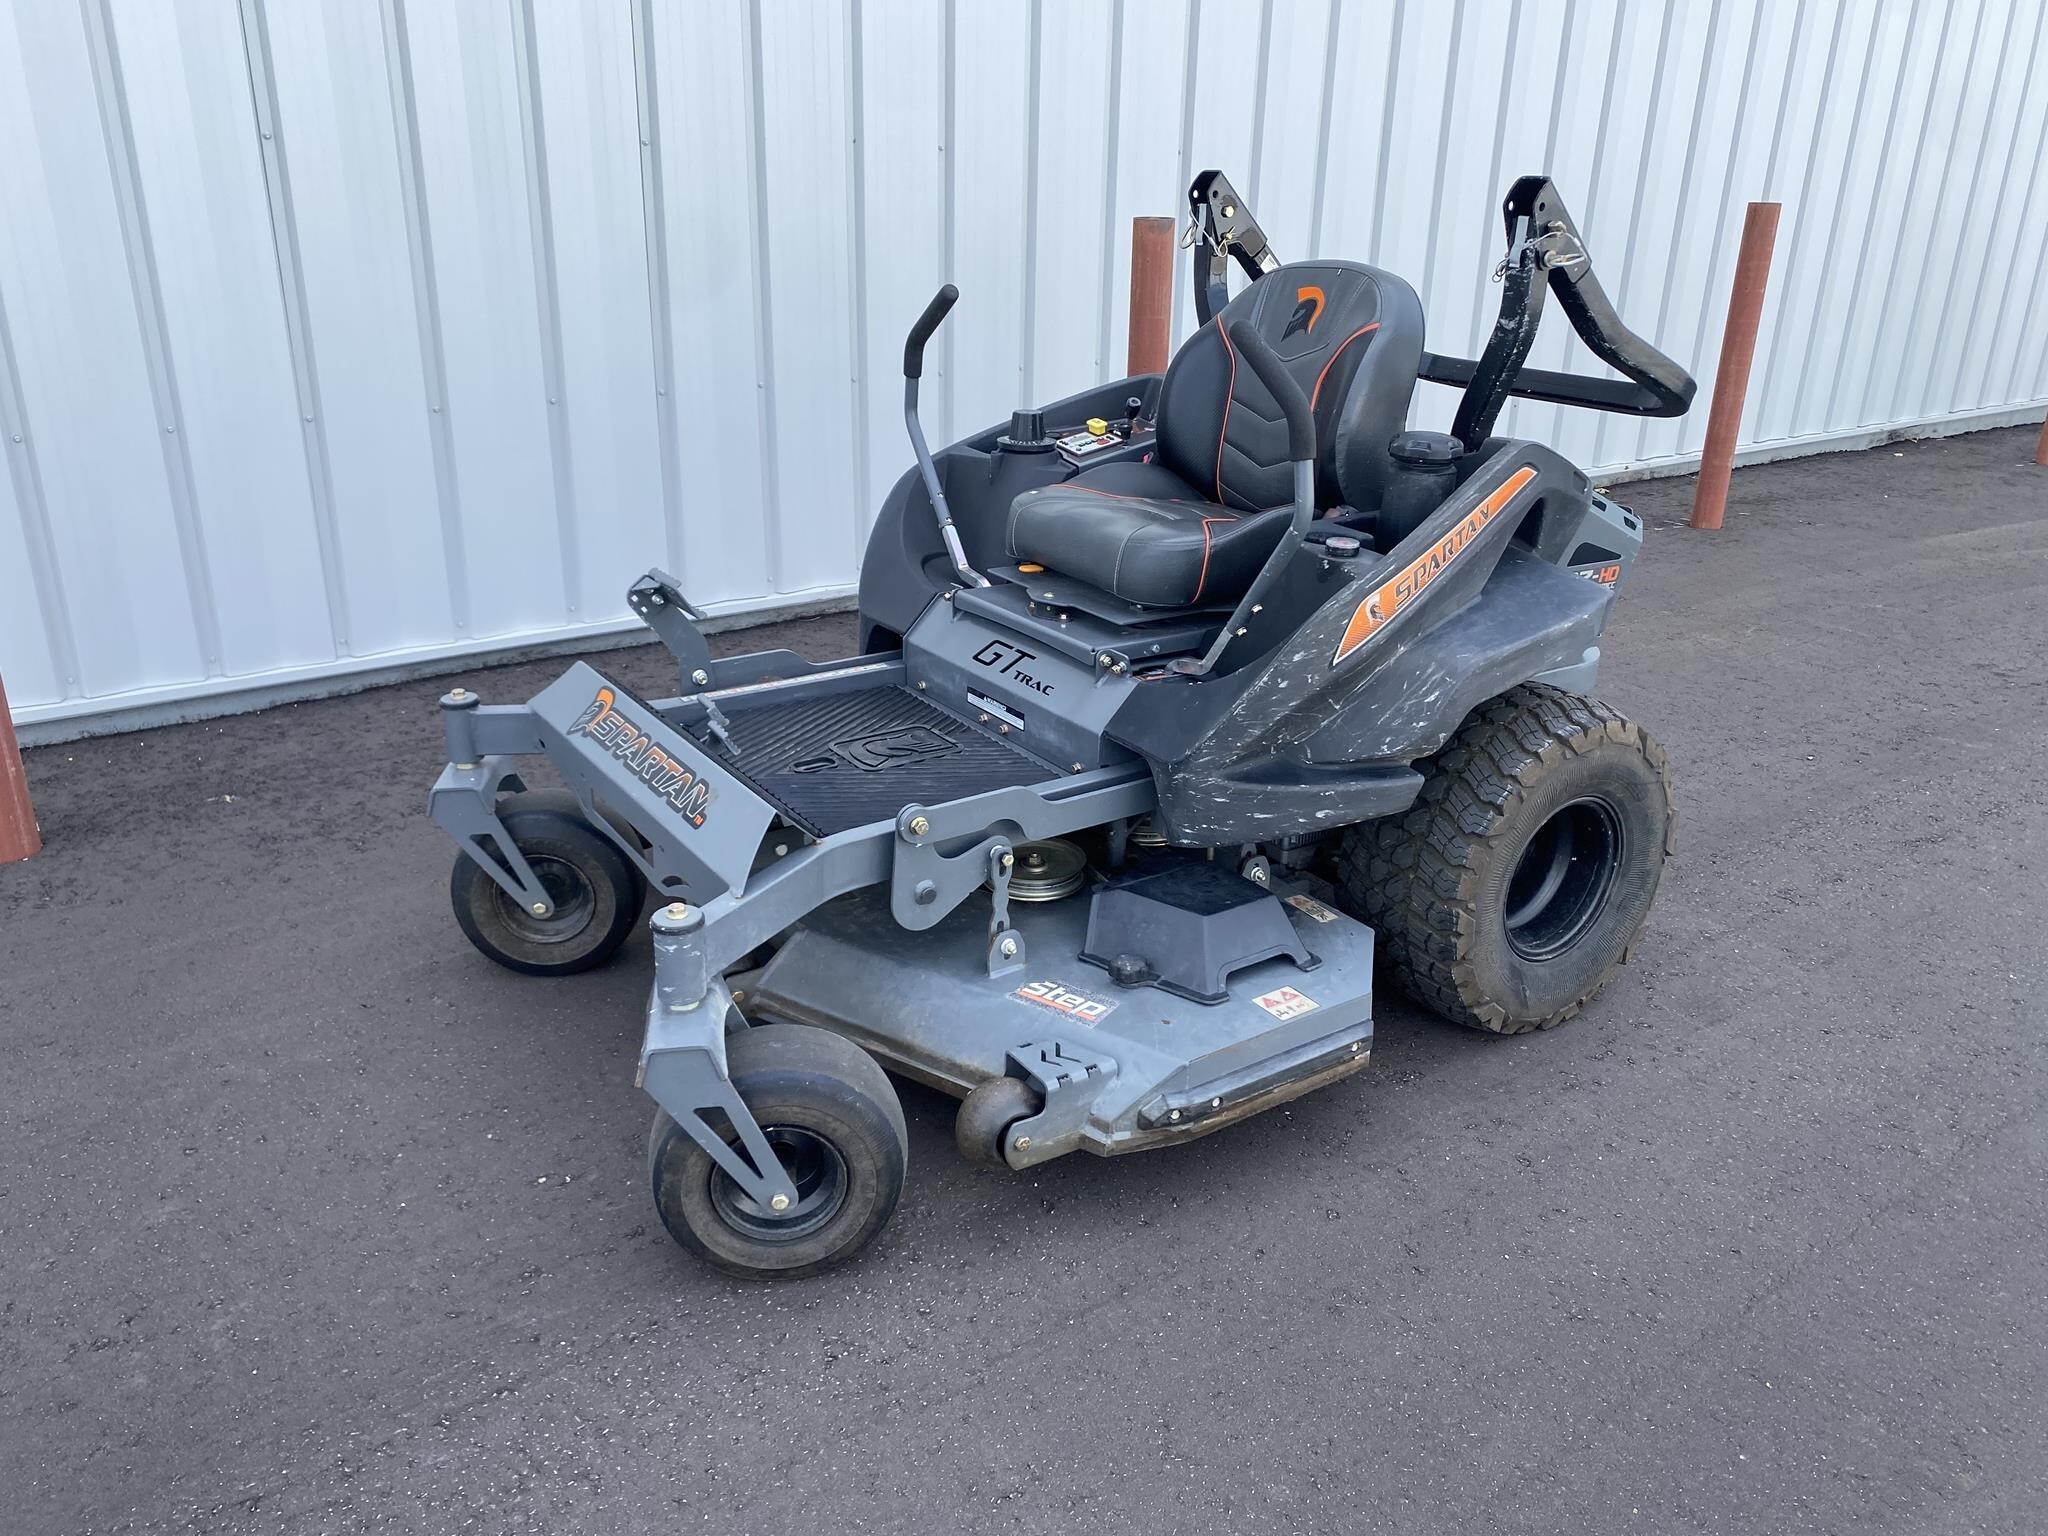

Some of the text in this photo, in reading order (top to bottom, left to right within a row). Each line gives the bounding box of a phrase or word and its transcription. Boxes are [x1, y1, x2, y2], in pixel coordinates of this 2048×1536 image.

[1394, 503, 1490, 608] SPARTAN
[972, 639, 1037, 674] GT
[1013, 670, 1055, 696] TRAC
[589, 709, 709, 819] SPARTAN
